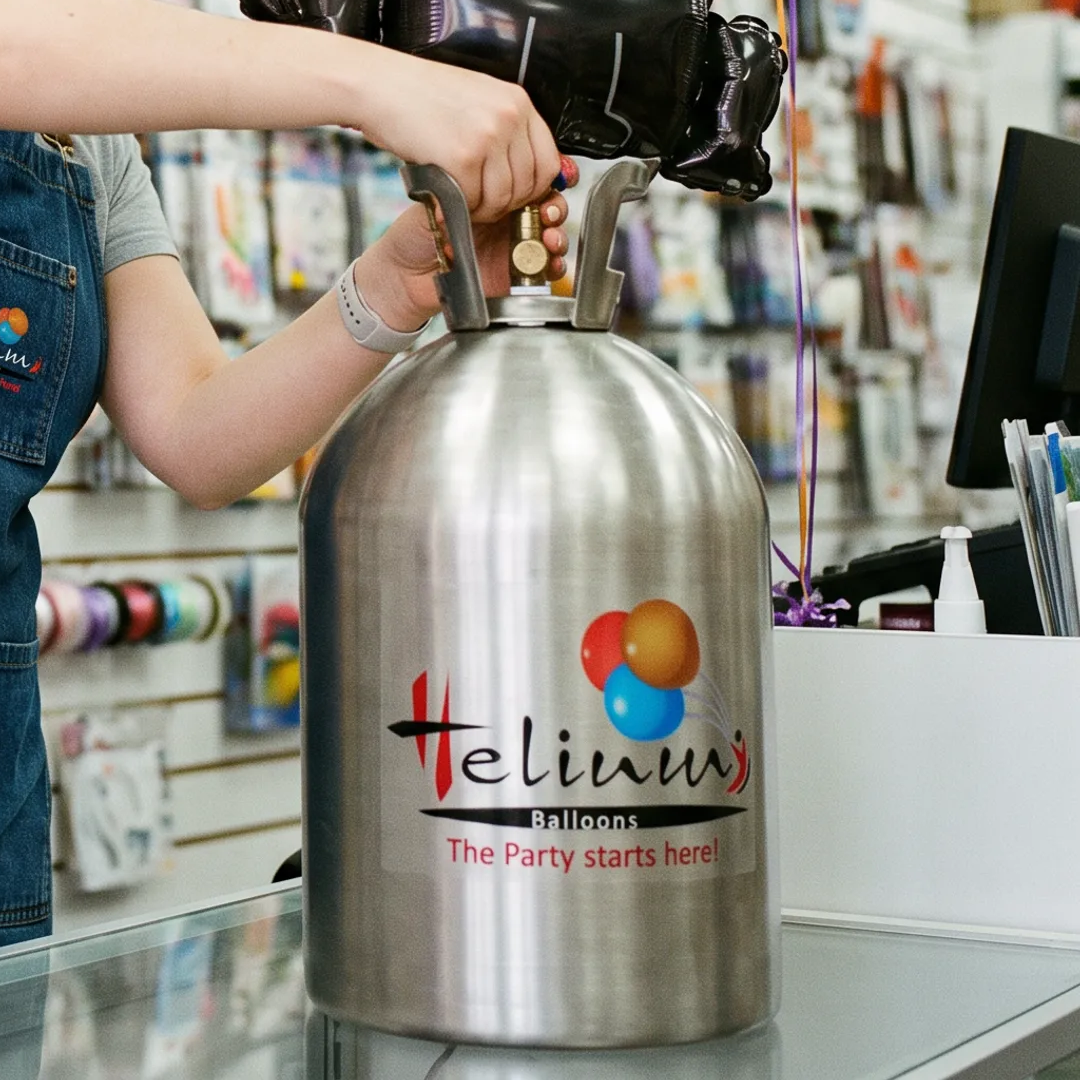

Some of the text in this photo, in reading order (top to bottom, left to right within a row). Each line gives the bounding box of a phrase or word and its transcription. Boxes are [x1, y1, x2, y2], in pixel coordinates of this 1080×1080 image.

[387, 670, 732, 802] Helium
[531, 810, 639, 830] Balloons
[447, 838, 719, 873] The Party starts here!
